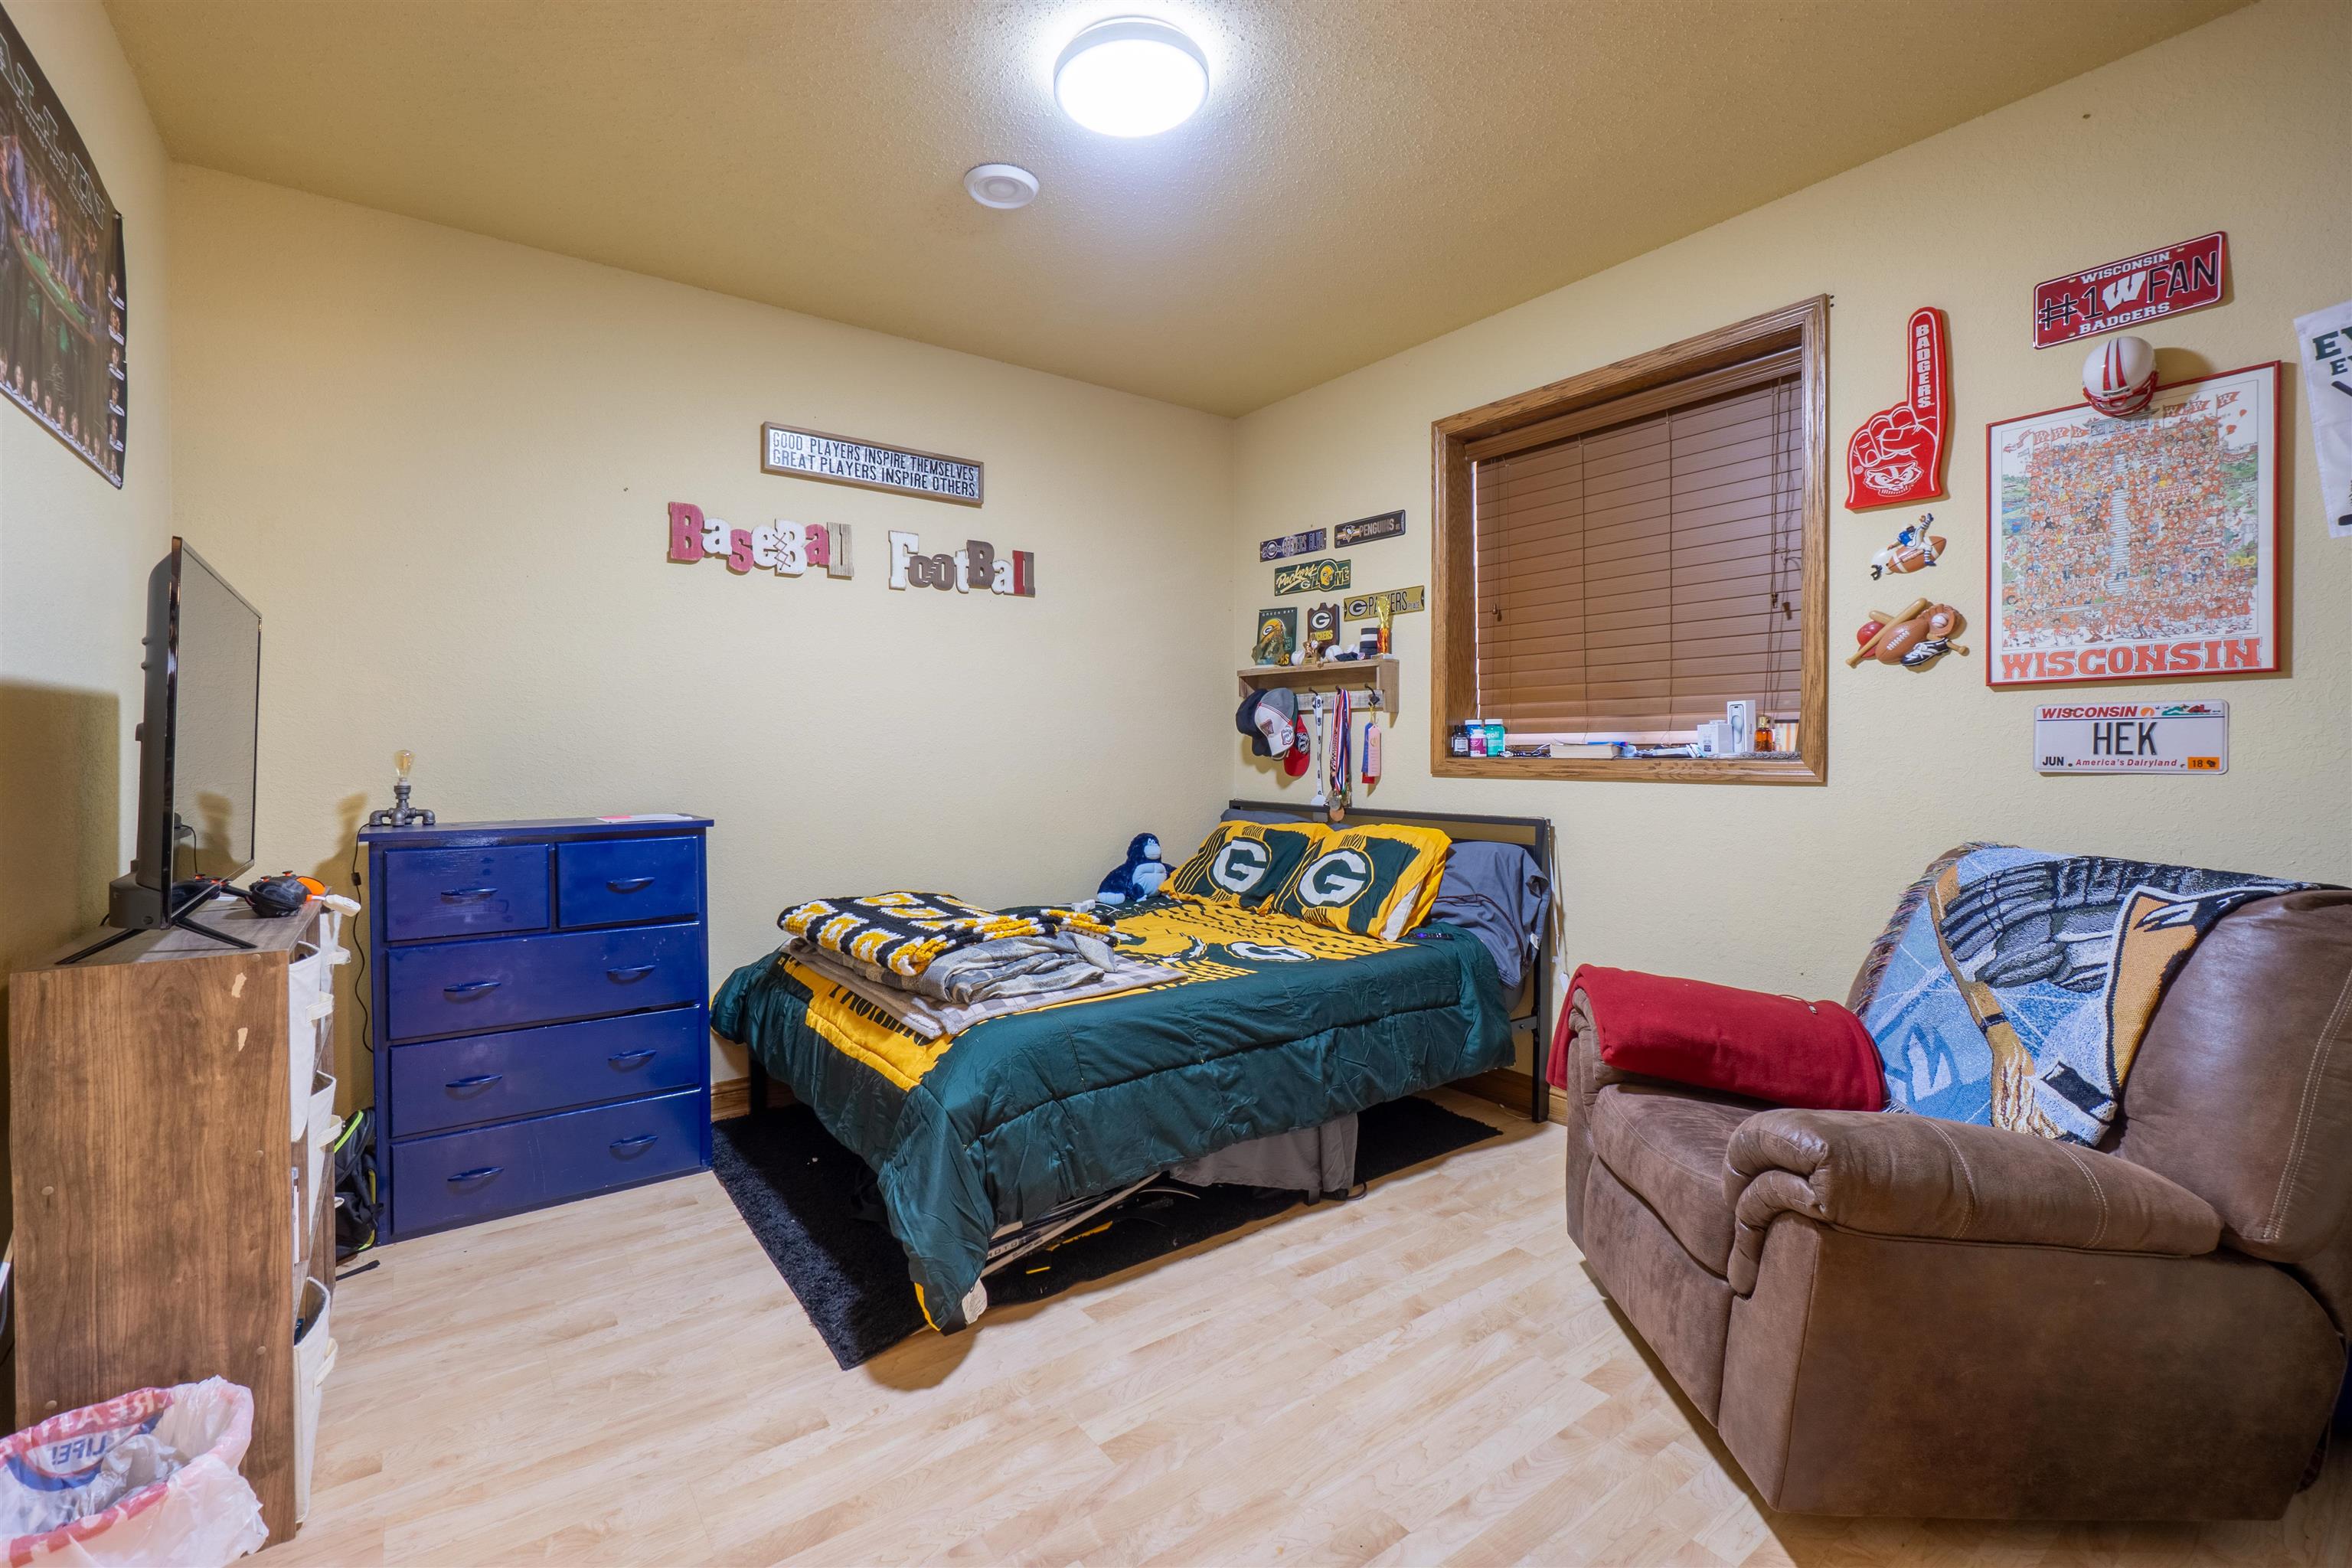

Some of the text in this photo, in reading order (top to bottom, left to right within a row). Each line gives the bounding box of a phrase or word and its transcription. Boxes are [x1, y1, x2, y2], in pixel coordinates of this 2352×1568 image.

[2079, 251, 2170, 285] WISCONSIN
[2038, 250, 2218, 332] #1 W FAN
[2079, 301, 2171, 335] BADGERS
[1916, 323, 1932, 410] BADGERS
[773, 431, 975, 482] GOOD PLAYERS INSPIRE THEMSELVES
[773, 449, 976, 498] GREAT PLAYERS INSPIRE OTHERS
[1359, 518, 1395, 537] PENGUINS
[1276, 564, 1317, 590] Packers
[2001, 636, 2264, 680] WISCONSIN
[2042, 706, 2138, 719] WISCONSIN
[2092, 721, 2158, 756] HEK
[2042, 756, 2203, 769] JUN America's Dairyland 18
